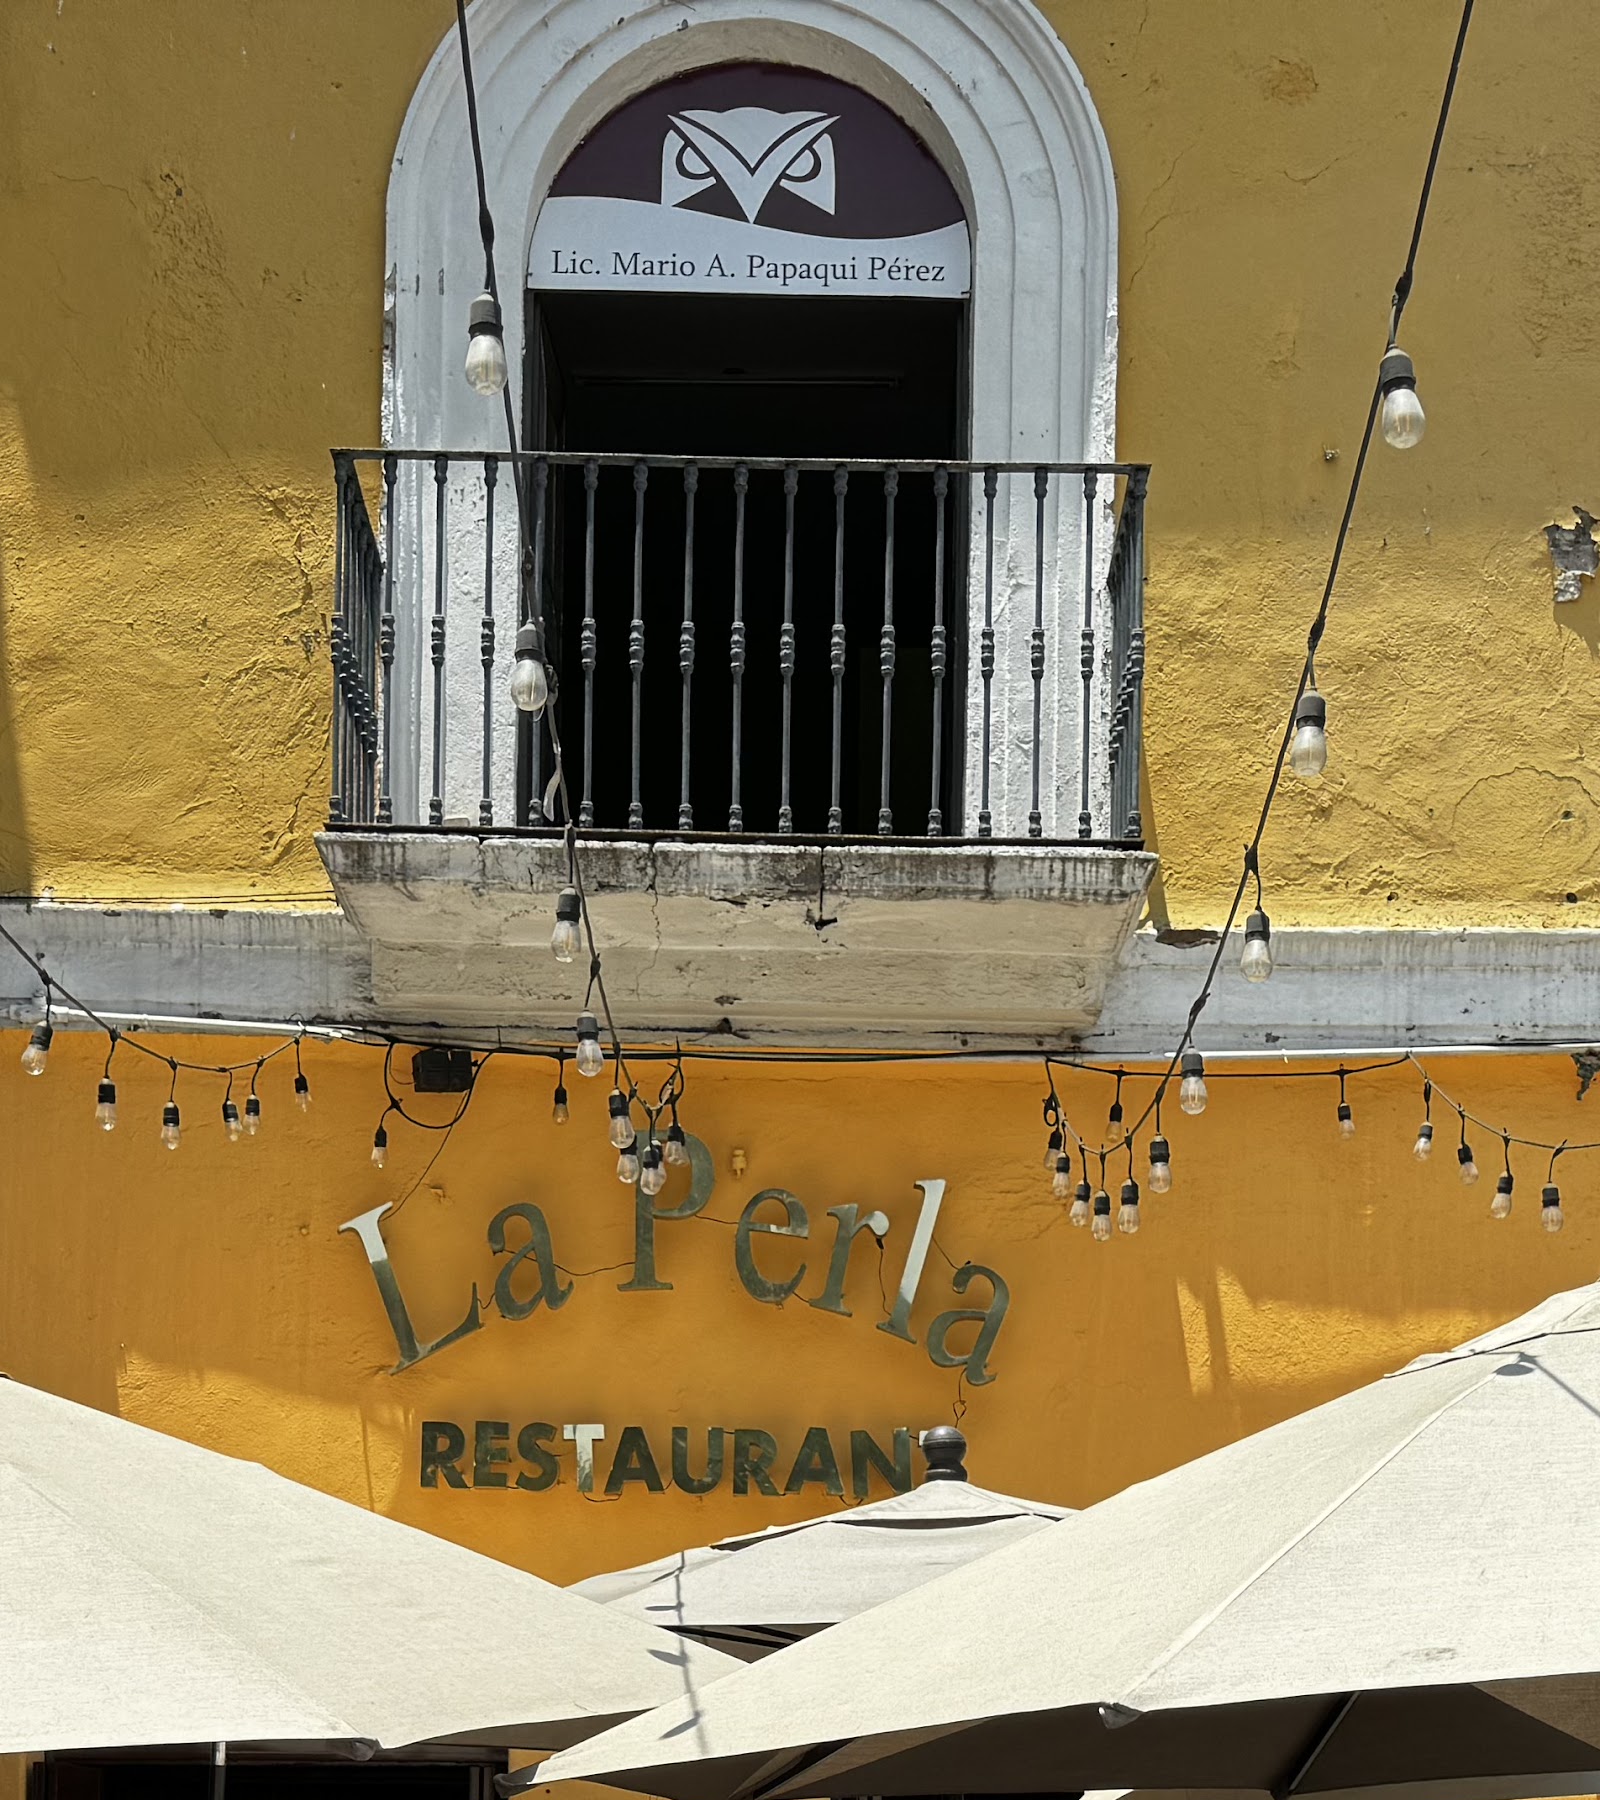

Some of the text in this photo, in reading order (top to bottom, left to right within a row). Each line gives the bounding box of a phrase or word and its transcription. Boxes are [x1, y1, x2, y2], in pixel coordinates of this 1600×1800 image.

[551, 250, 946, 288] Lic. Mario A. Papaqui Pérez
[337, 1130, 1011, 1387] La Perla
[419, 1419, 928, 1500] RESTAURAN
